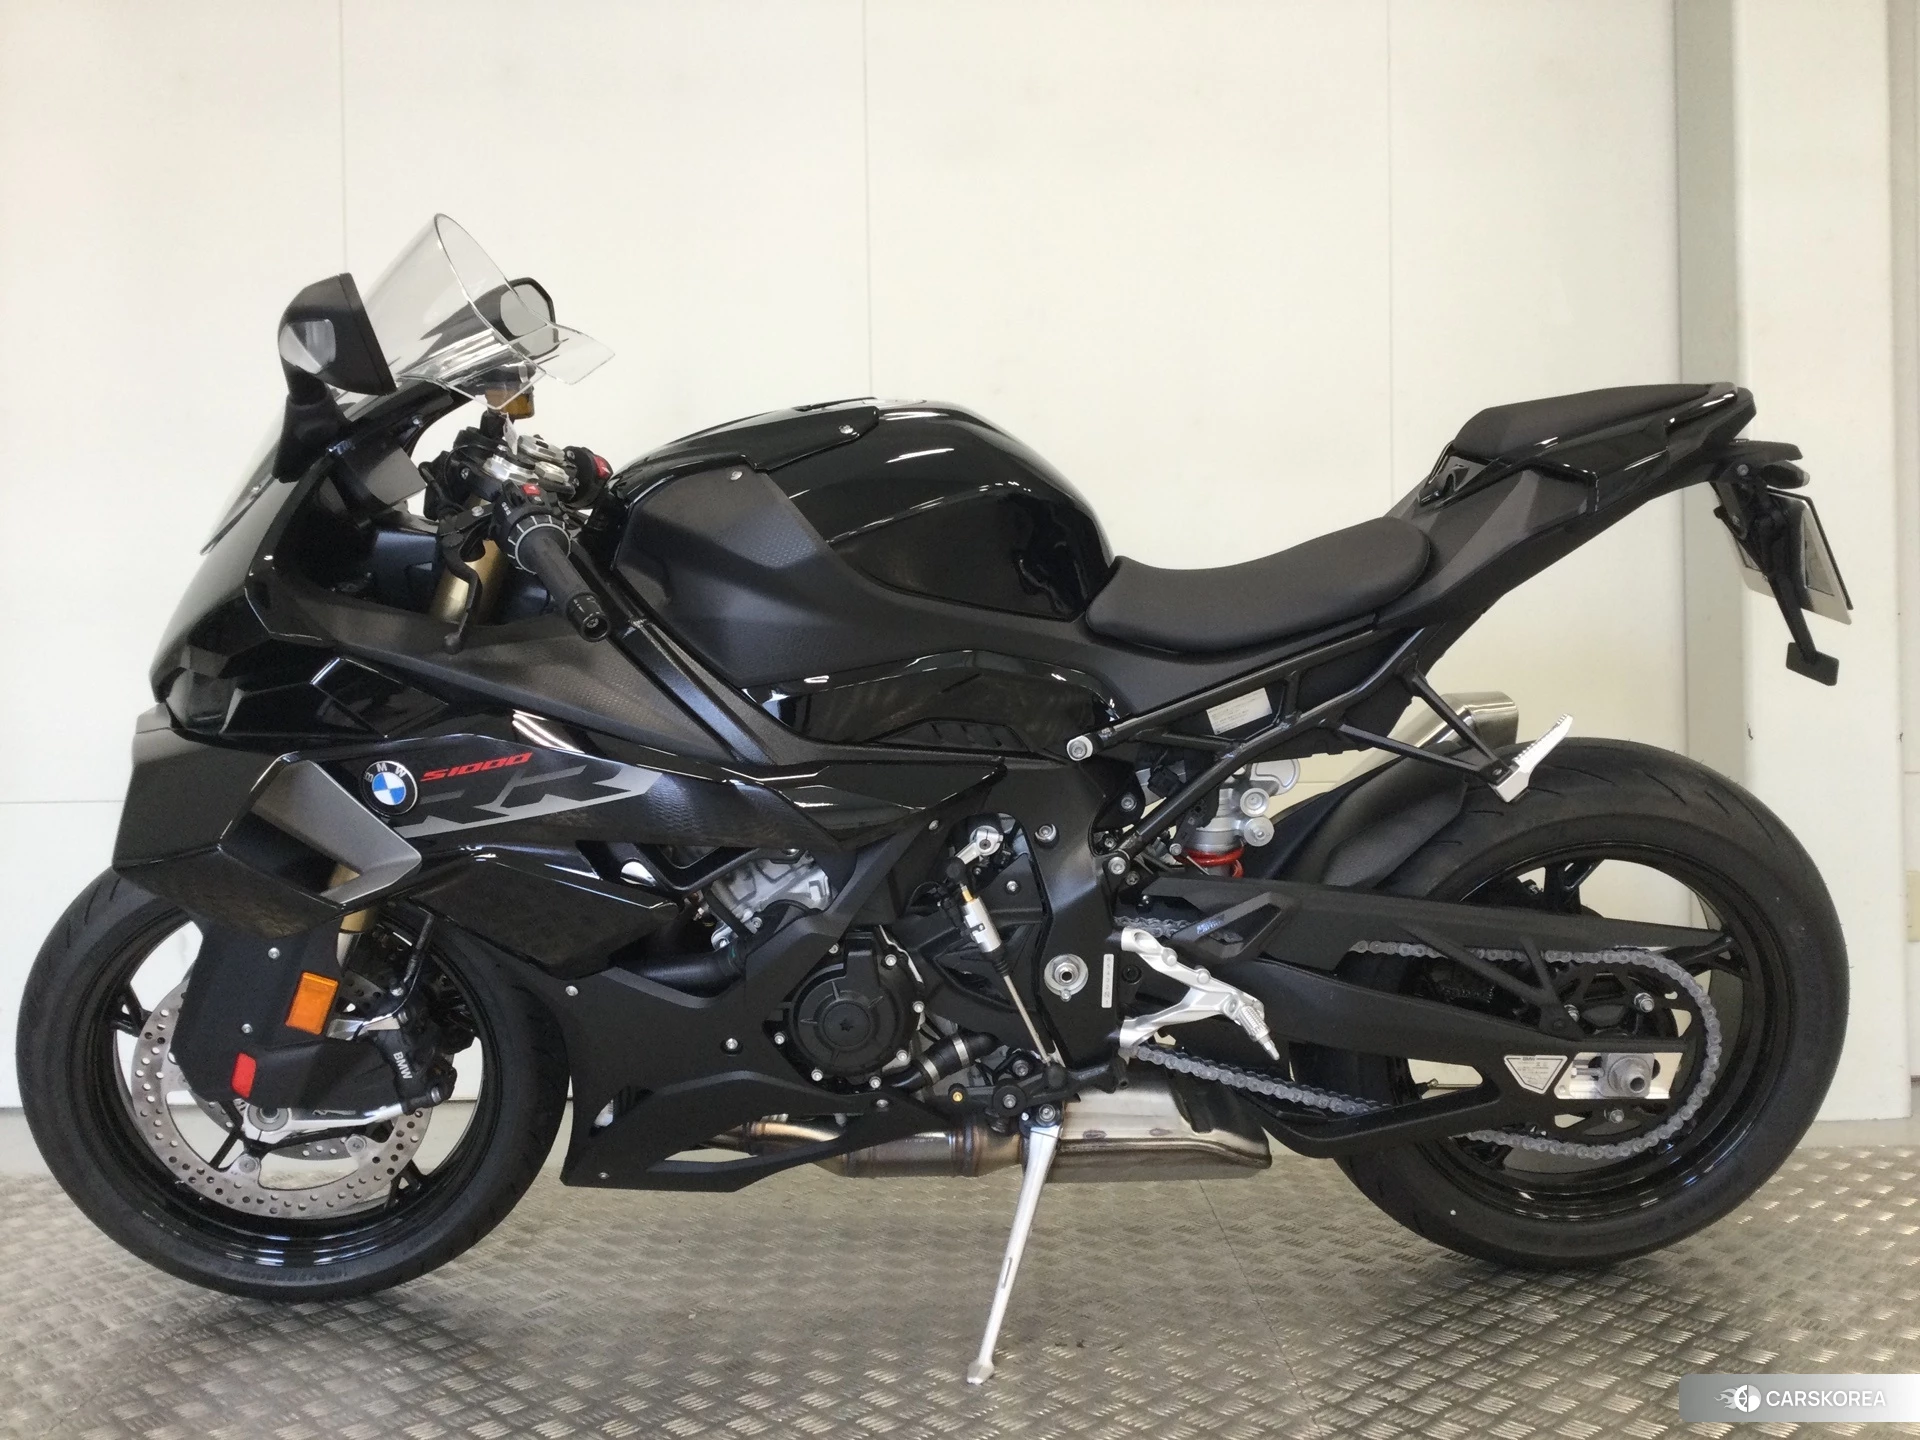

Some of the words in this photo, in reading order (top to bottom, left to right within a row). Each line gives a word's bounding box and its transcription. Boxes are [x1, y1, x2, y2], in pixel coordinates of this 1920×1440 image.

[363, 762, 407, 783] BMW
[420, 752, 533, 782] S1000
[393, 1051, 413, 1079] BMW
